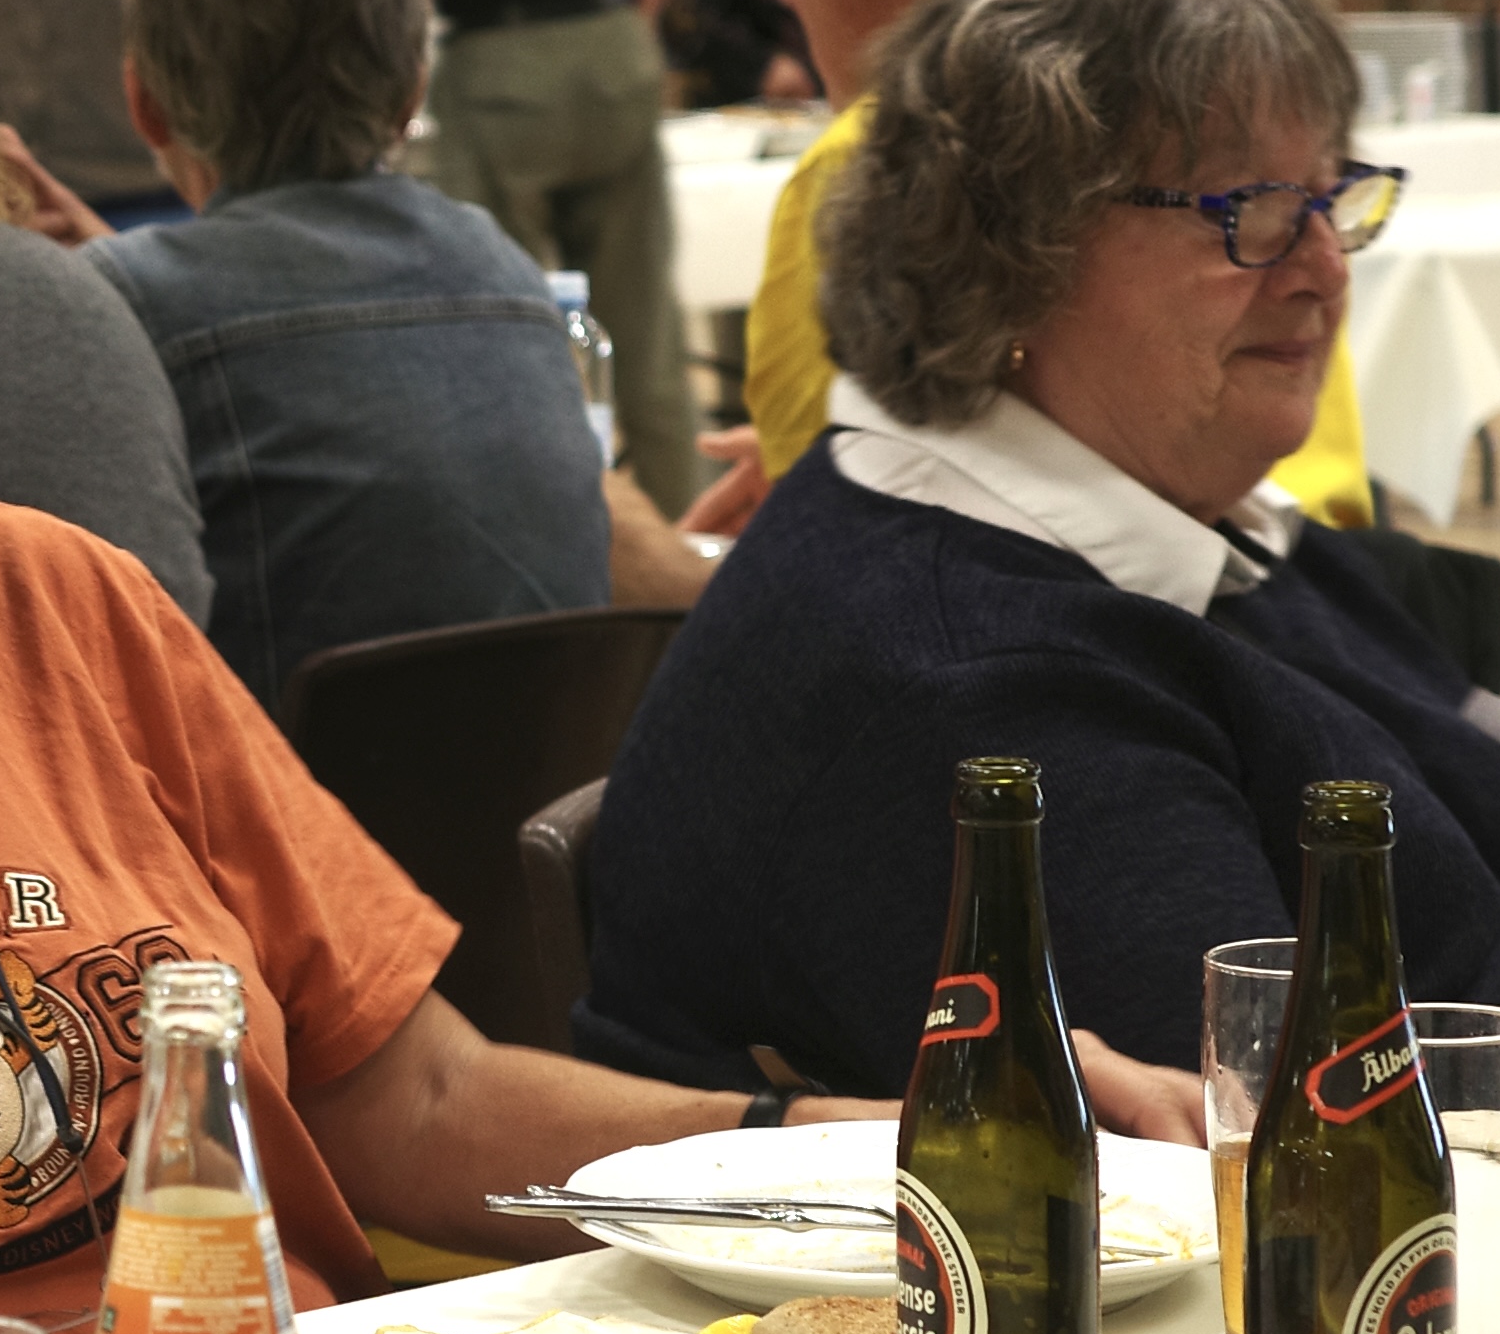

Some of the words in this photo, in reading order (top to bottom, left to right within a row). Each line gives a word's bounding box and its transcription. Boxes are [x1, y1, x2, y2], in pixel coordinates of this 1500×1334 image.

[906, 1196, 935, 1232] ANDRE
[934, 1231, 953, 1262] FINE
[948, 1263, 967, 1316] STEDER
[1373, 1277, 1395, 1315] KOLD
[1394, 1255, 1410, 1280] PÅ
[1408, 1240, 1431, 1266] FYN
